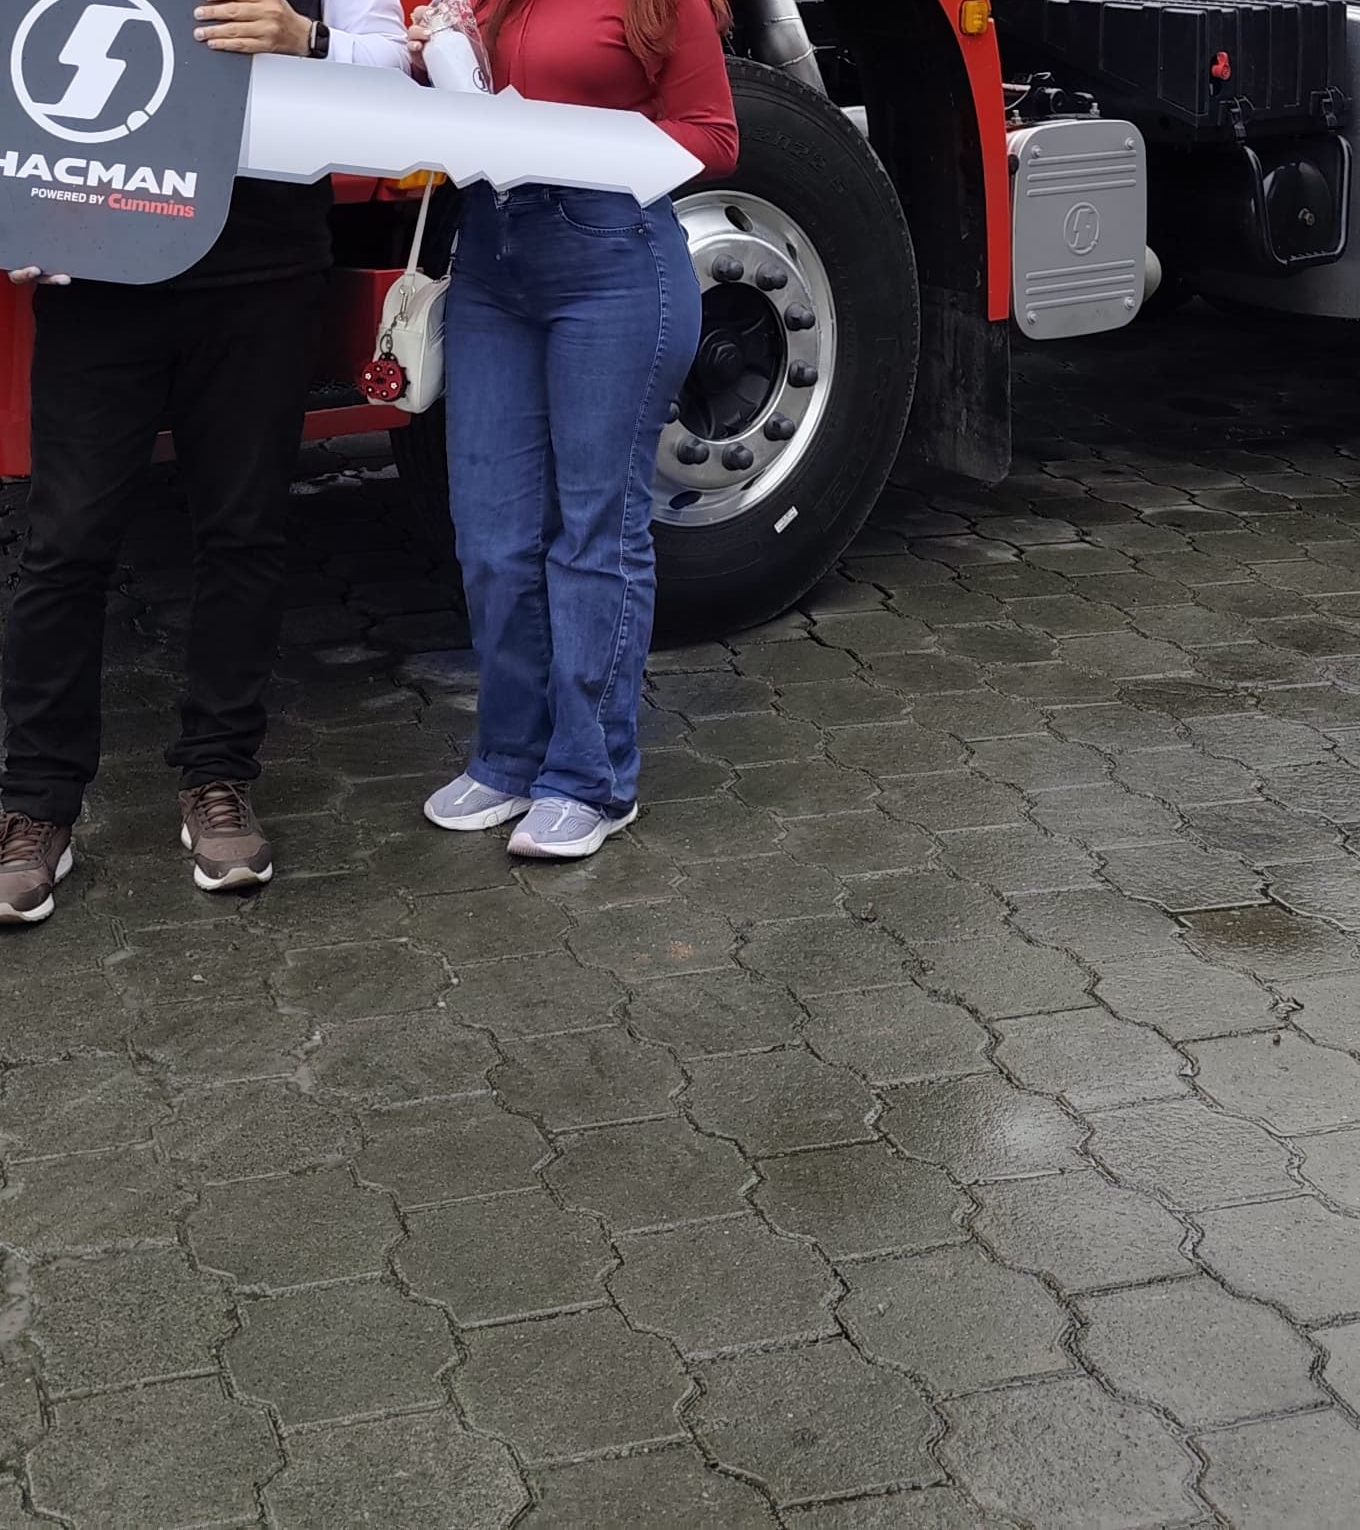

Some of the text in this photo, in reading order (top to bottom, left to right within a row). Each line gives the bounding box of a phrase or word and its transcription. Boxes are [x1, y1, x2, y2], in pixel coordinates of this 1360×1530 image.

[31, 187, 194, 218] POWERED BY Cummins
